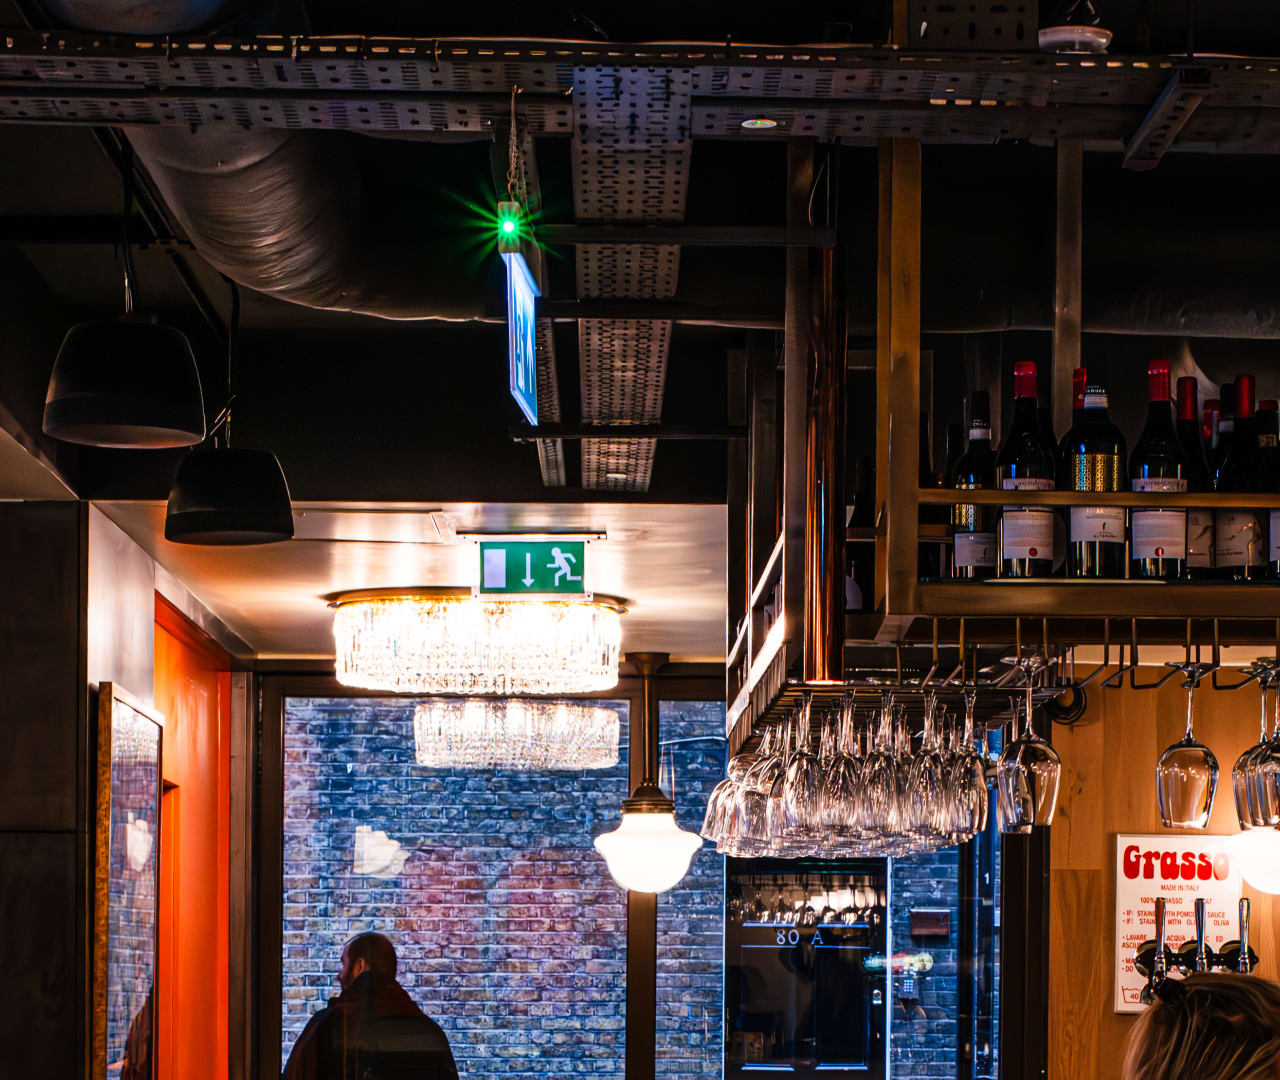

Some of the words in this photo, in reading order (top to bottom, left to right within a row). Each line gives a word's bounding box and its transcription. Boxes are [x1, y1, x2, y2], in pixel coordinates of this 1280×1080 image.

[1123, 845, 1230, 880] Grasso
[776, 928, 800, 945] 80
[810, 929, 824, 945] A
